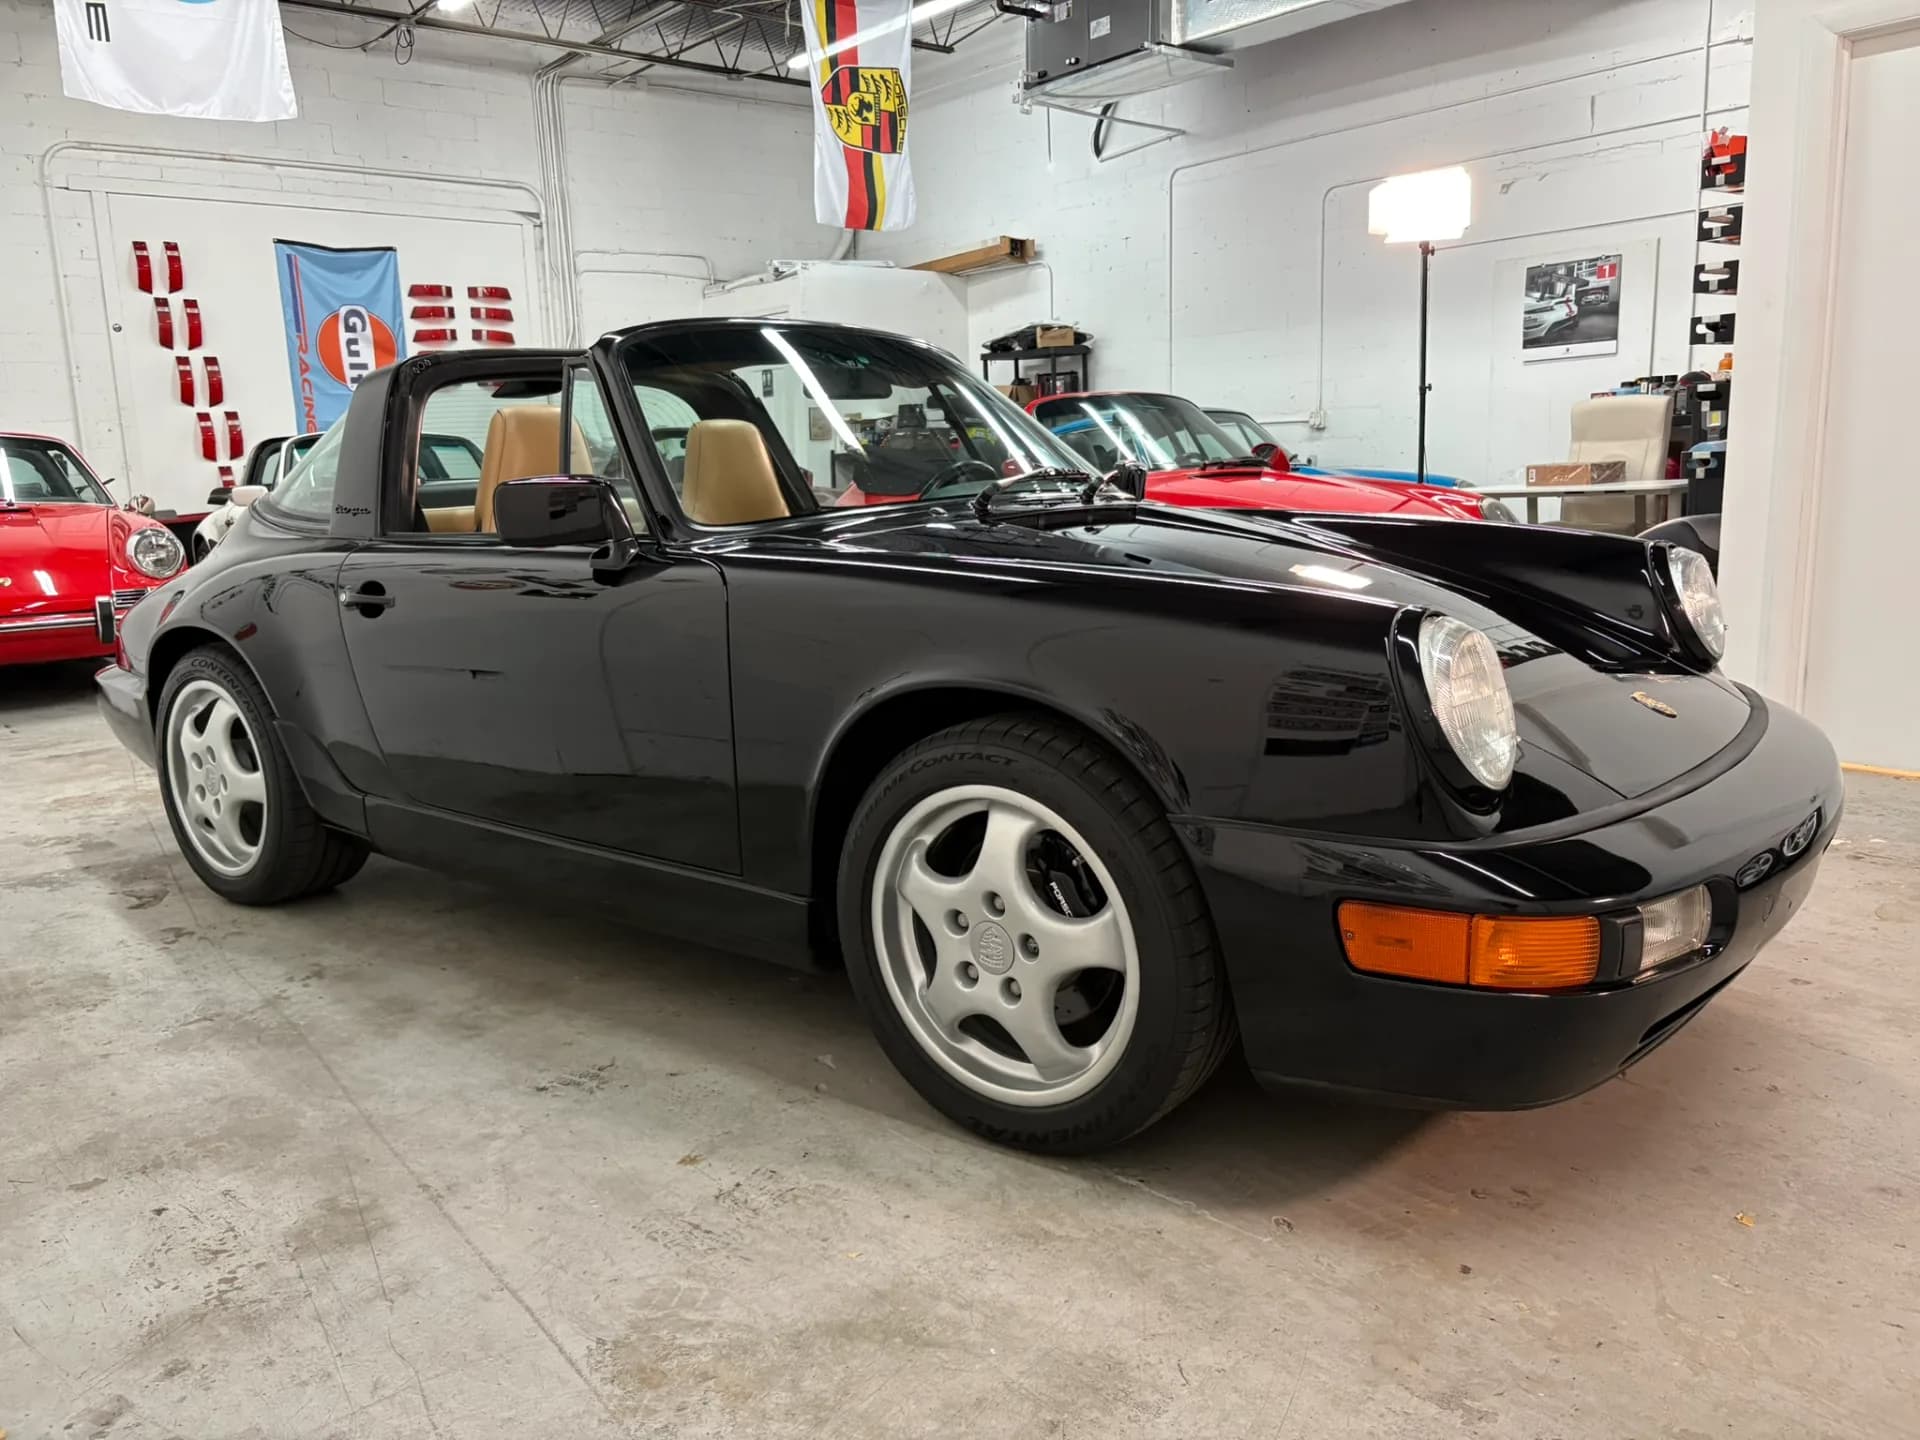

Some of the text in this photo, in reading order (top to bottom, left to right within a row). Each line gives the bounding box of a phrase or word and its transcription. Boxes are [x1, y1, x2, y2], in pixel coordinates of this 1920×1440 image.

[893, 70, 906, 154] PORSCHE
[297, 335, 318, 434] RACING
[1049, 881, 1073, 918] PORSC
